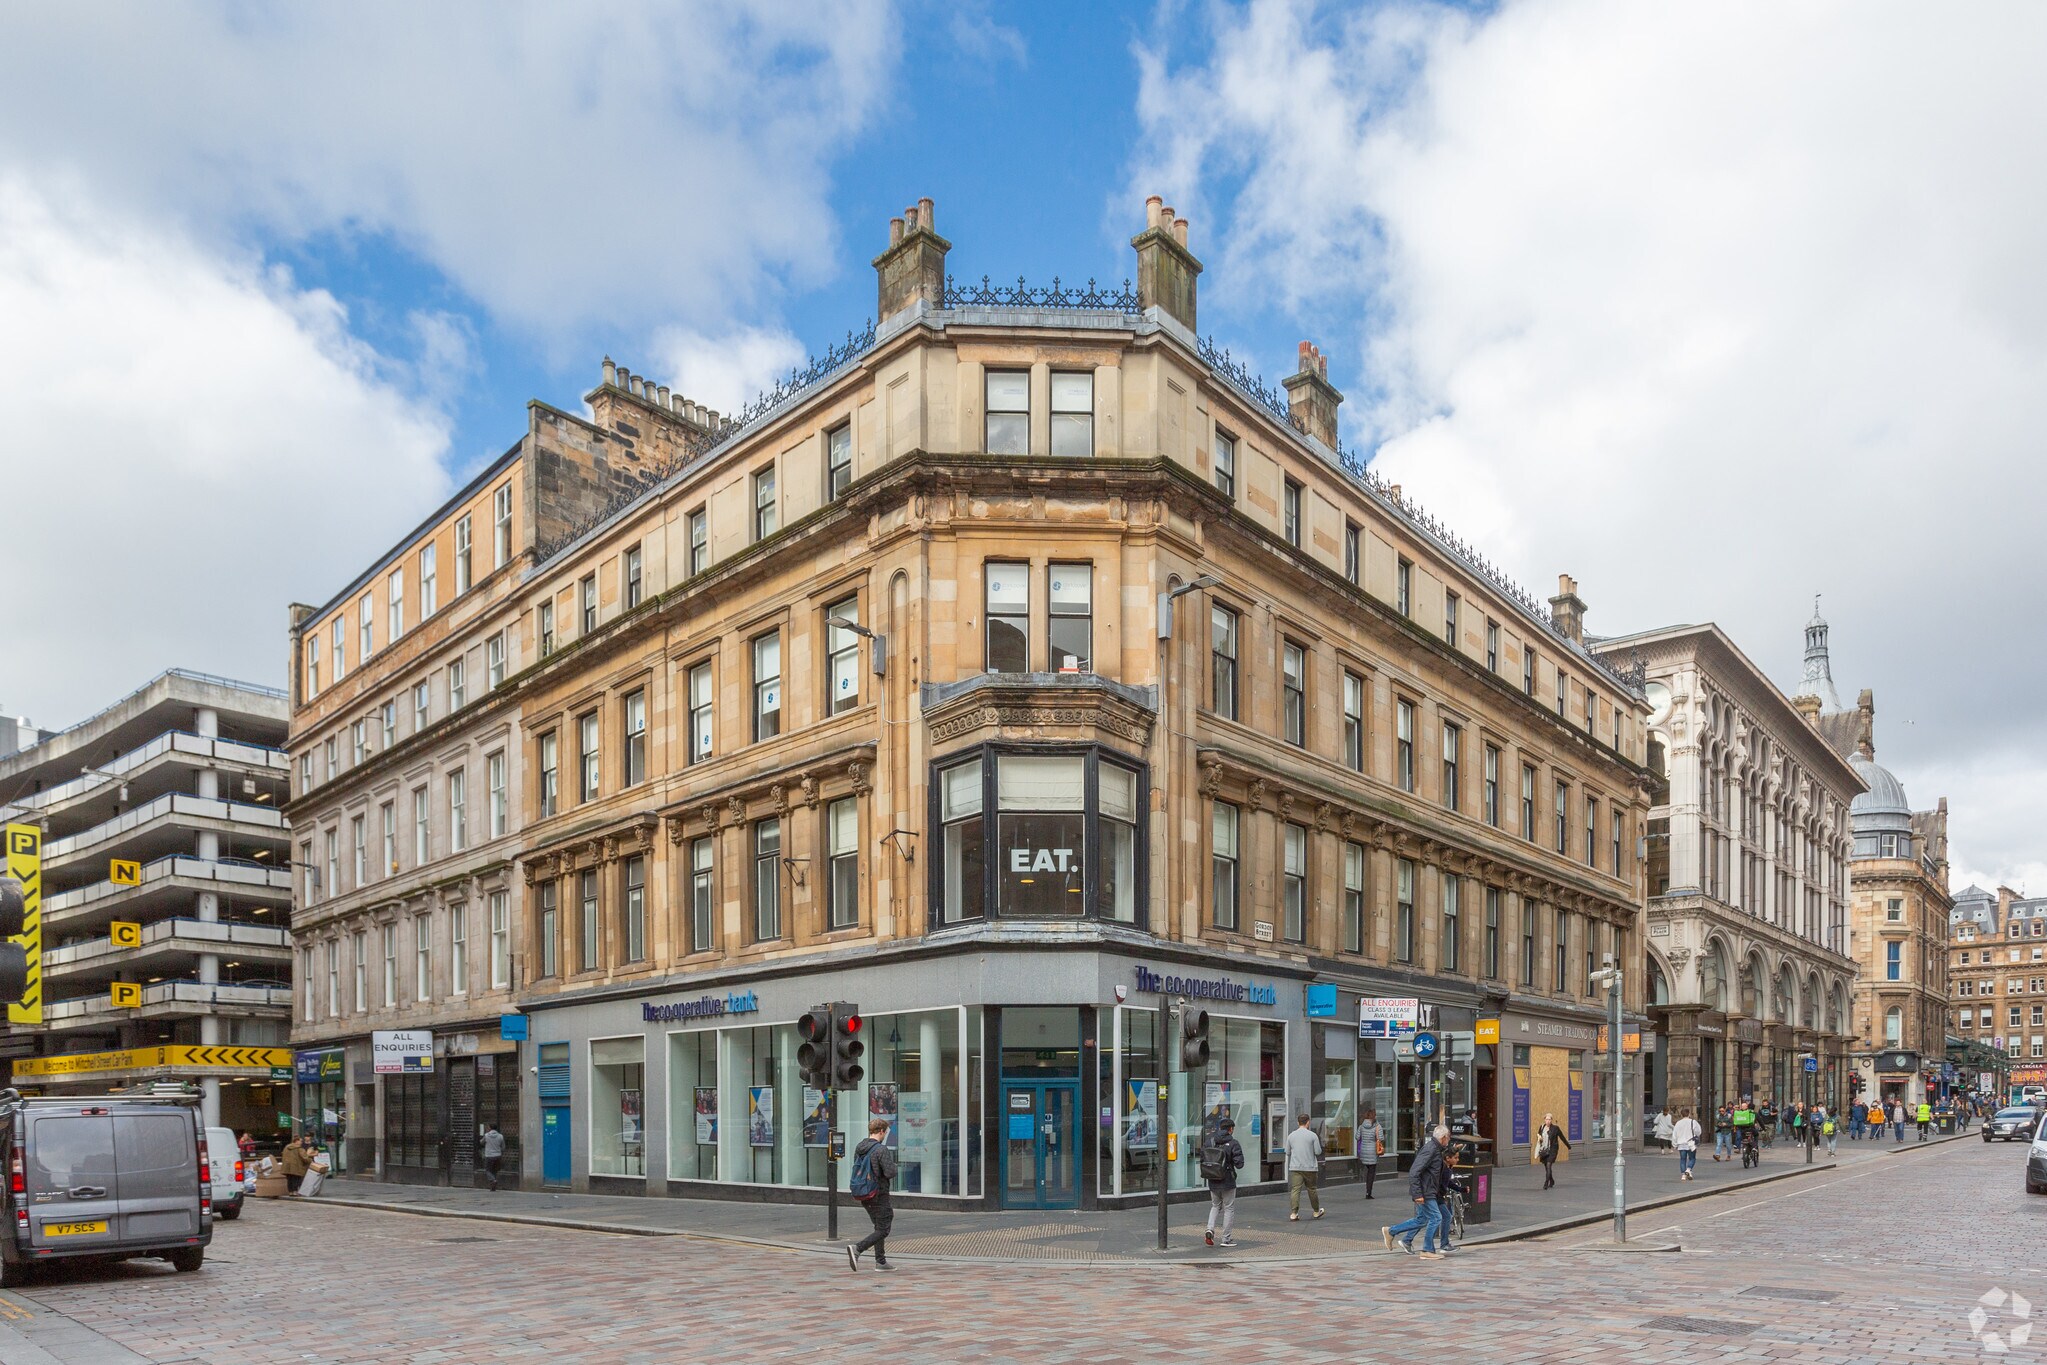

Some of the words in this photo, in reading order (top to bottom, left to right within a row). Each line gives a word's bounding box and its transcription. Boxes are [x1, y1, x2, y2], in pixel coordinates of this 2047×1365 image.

[15, 833, 34, 853] P
[1011, 848, 1078, 873] EAT.
[117, 865, 134, 880] N
[117, 927, 133, 942] C
[1255, 929, 1272, 937] STREET
[1135, 965, 1160, 992] The
[1248, 980, 1277, 1005] bank
[119, 987, 134, 1002] P
[641, 1002, 658, 1021] The
[727, 989, 757, 1013] bank
[1537, 1023, 1563, 1036] STEAMER
[1564, 1026, 1588, 1040] TRADING
[374, 1043, 432, 1051] ENQUIRIES
[44, 1061, 68, 1072] Welcome
[69, 1060, 75, 1070] to
[57, 1225, 72, 1234] V7
[74, 1223, 96, 1233] SCS
